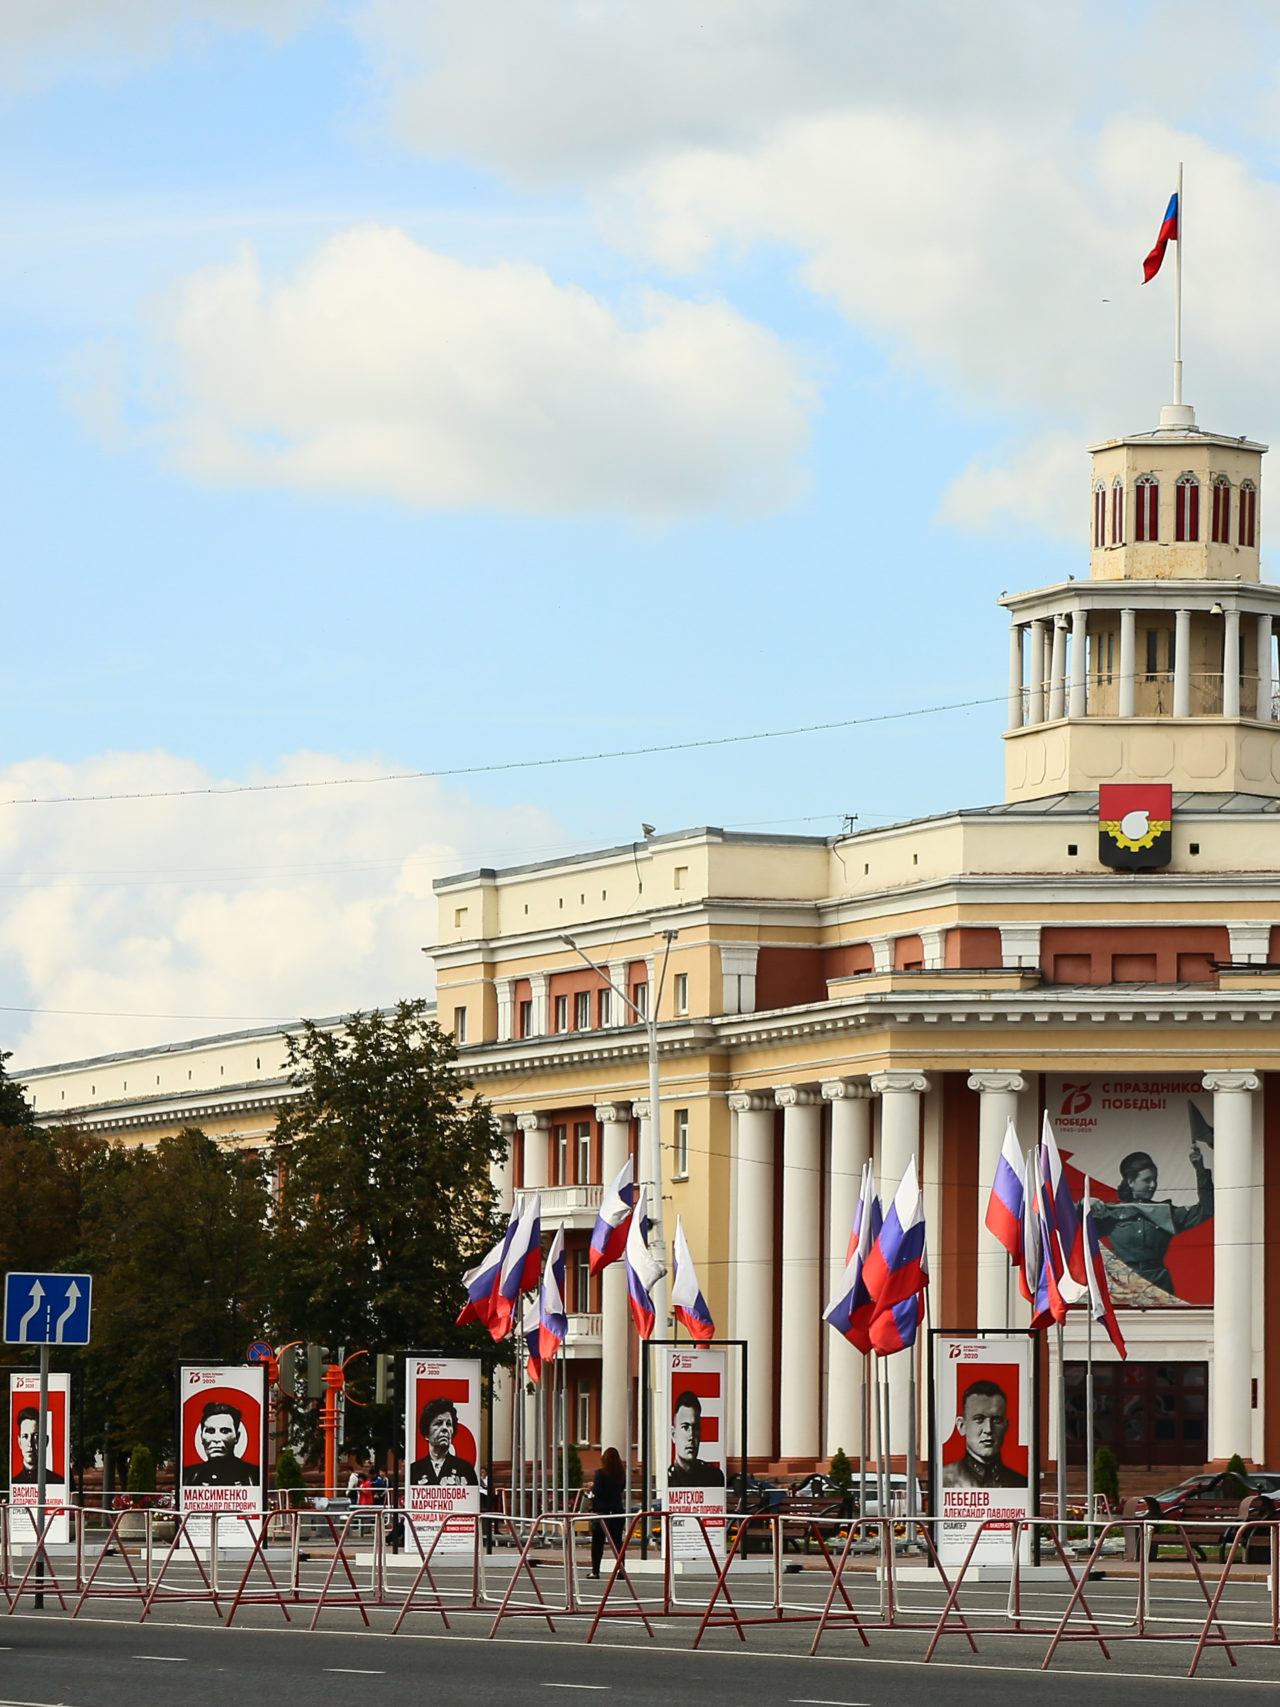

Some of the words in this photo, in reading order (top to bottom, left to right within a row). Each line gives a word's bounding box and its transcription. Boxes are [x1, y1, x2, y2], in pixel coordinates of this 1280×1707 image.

[1102, 1083, 1110, 1094] С
[1114, 1082, 1208, 1094] ПРАЗДНИКО
[1061, 1082, 1092, 1115] 75
[1102, 1099, 1167, 1111] ПОБЕДЫ!
[1055, 1118, 1097, 1127] ПОБЕДА!
[949, 1344, 961, 1359] 75
[416, 1362, 426, 1375] 75
[189, 1372, 201, 1384] 75
[13, 1487, 40, 1498] ВАСИЛЬ
[184, 1489, 248, 1501] МАКСИМЕНКО
[412, 1488, 469, 1500] ТУСНОЛОБОВА-
[669, 1491, 704, 1504] МАРТЕХОВ
[412, 1500, 453, 1511] МАРЧЕНКО
[944, 1492, 990, 1508] ЛЕБЕДЕВ
[184, 1502, 222, 1511] АЛЕКСАНДР
[224, 1502, 256, 1511] ПЕТРОВИЧ
[944, 1508, 985, 1518] АЛЕКСАНДР
[987, 1508, 1026, 1518] ПАВЛОВИЧ
[943, 1522, 967, 1530] СНАЙПЕР
